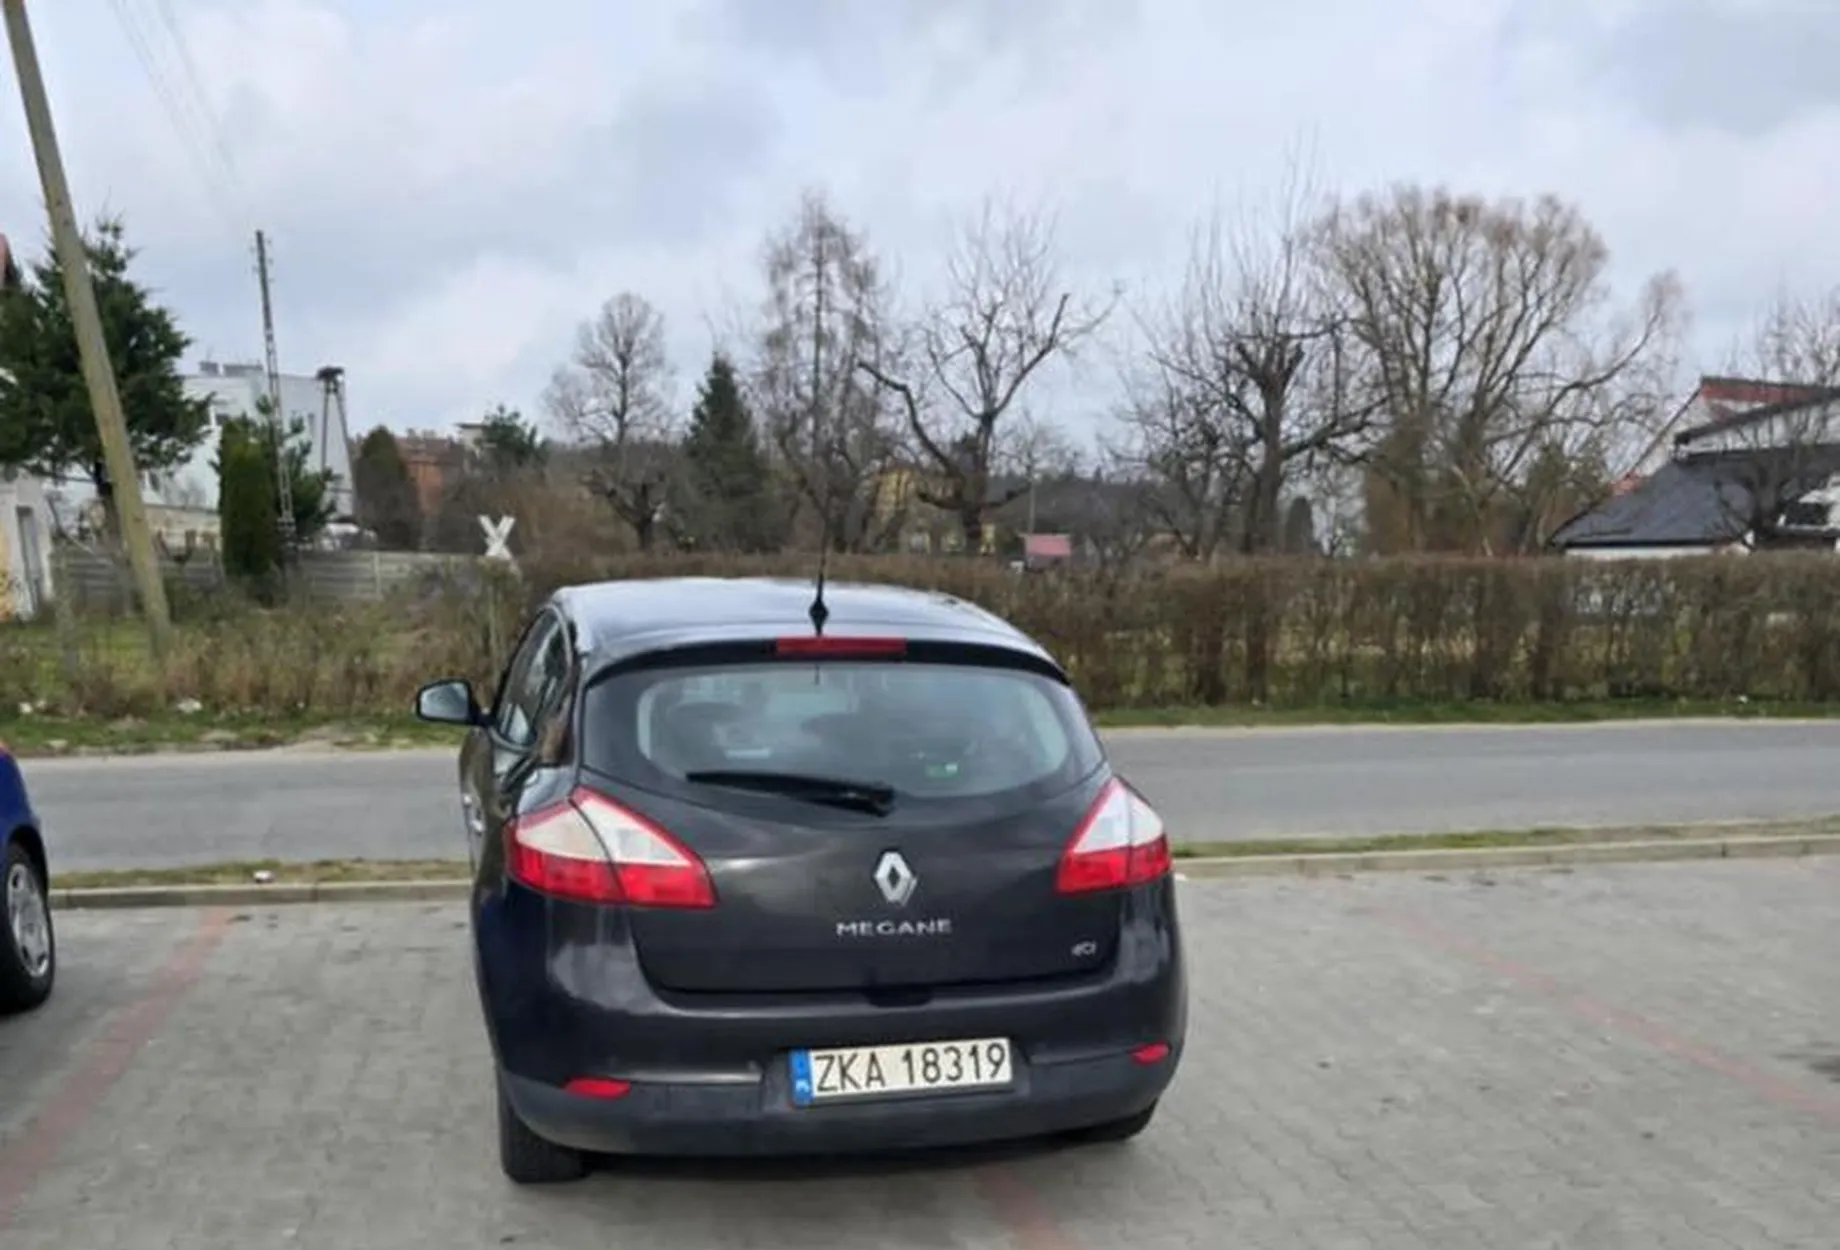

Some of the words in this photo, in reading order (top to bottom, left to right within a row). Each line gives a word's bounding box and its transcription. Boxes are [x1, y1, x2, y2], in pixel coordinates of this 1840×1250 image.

[836, 918, 952, 937] MEGANE
[814, 1051, 886, 1093] ZKA
[902, 1042, 1006, 1085] 18319
